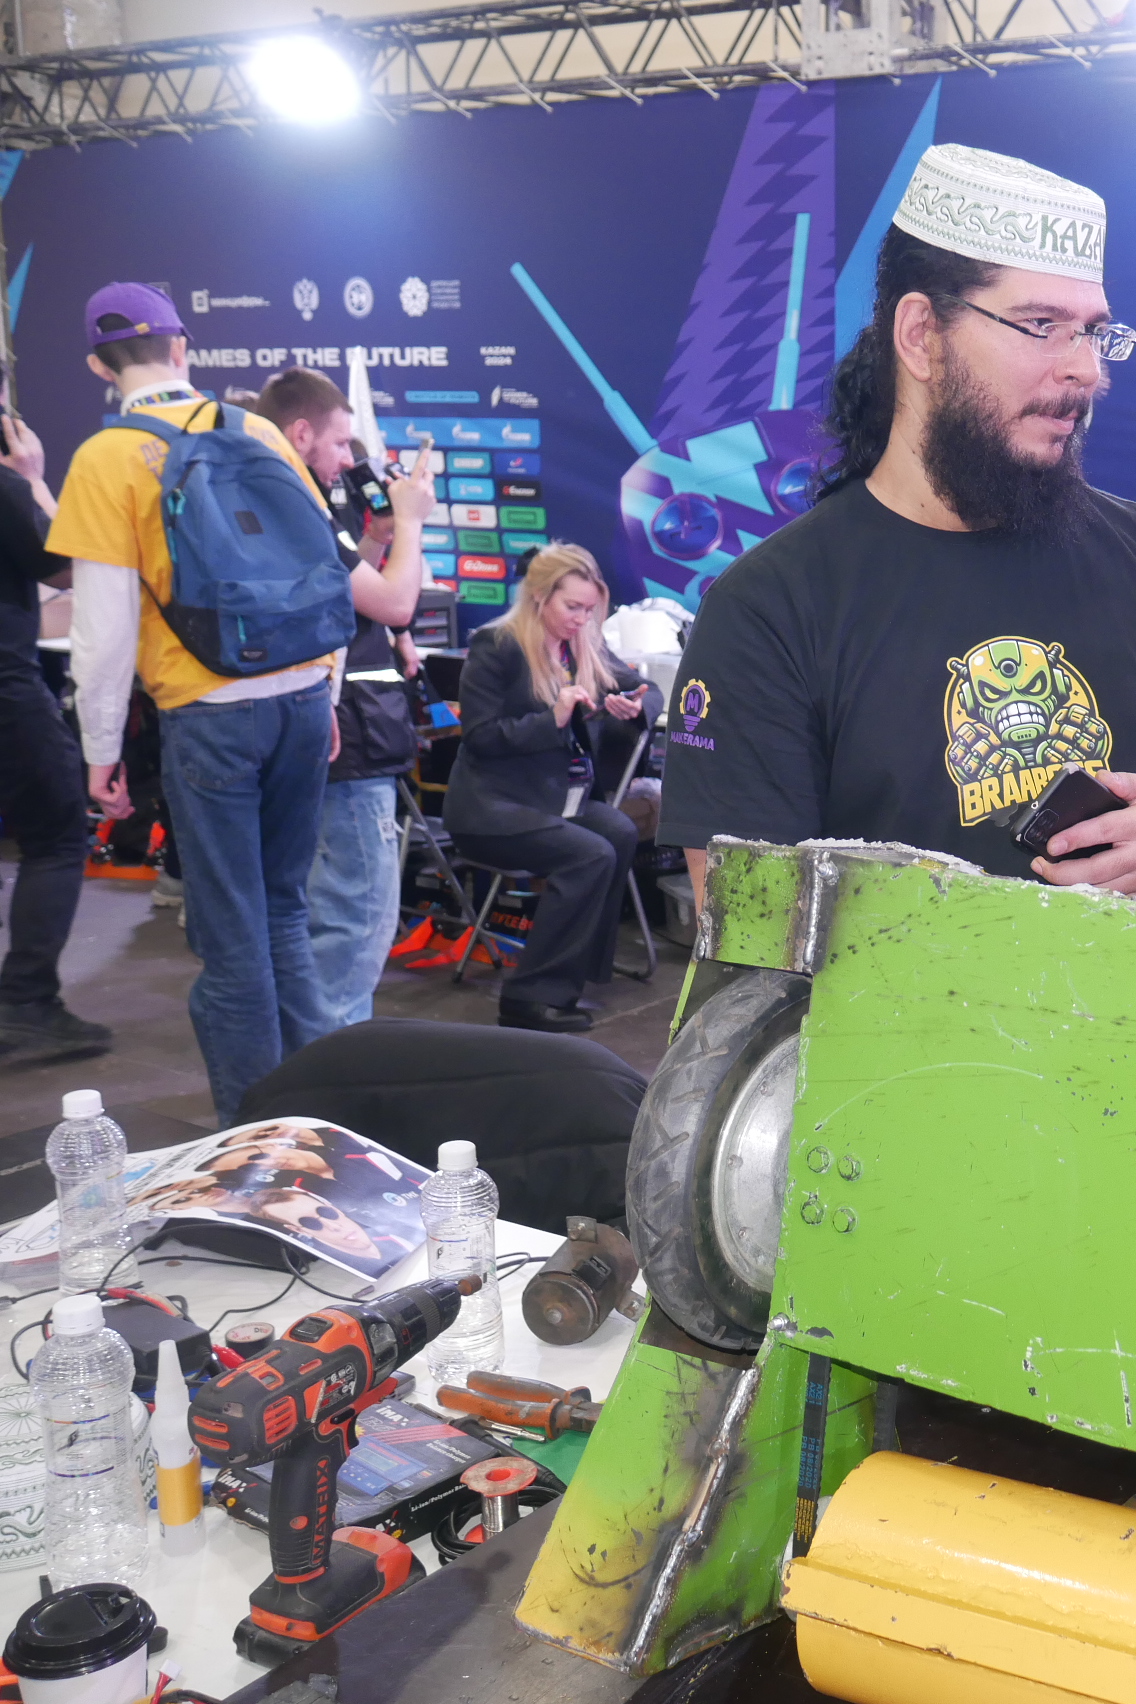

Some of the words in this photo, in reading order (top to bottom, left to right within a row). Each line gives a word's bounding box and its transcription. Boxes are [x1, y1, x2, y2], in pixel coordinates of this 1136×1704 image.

[1039, 214, 1105, 262] KAZA
[186, 348, 252, 368] AMES
[255, 348, 288, 367] OF
[291, 347, 341, 367] THE
[670, 731, 715, 751] MAKERAMA
